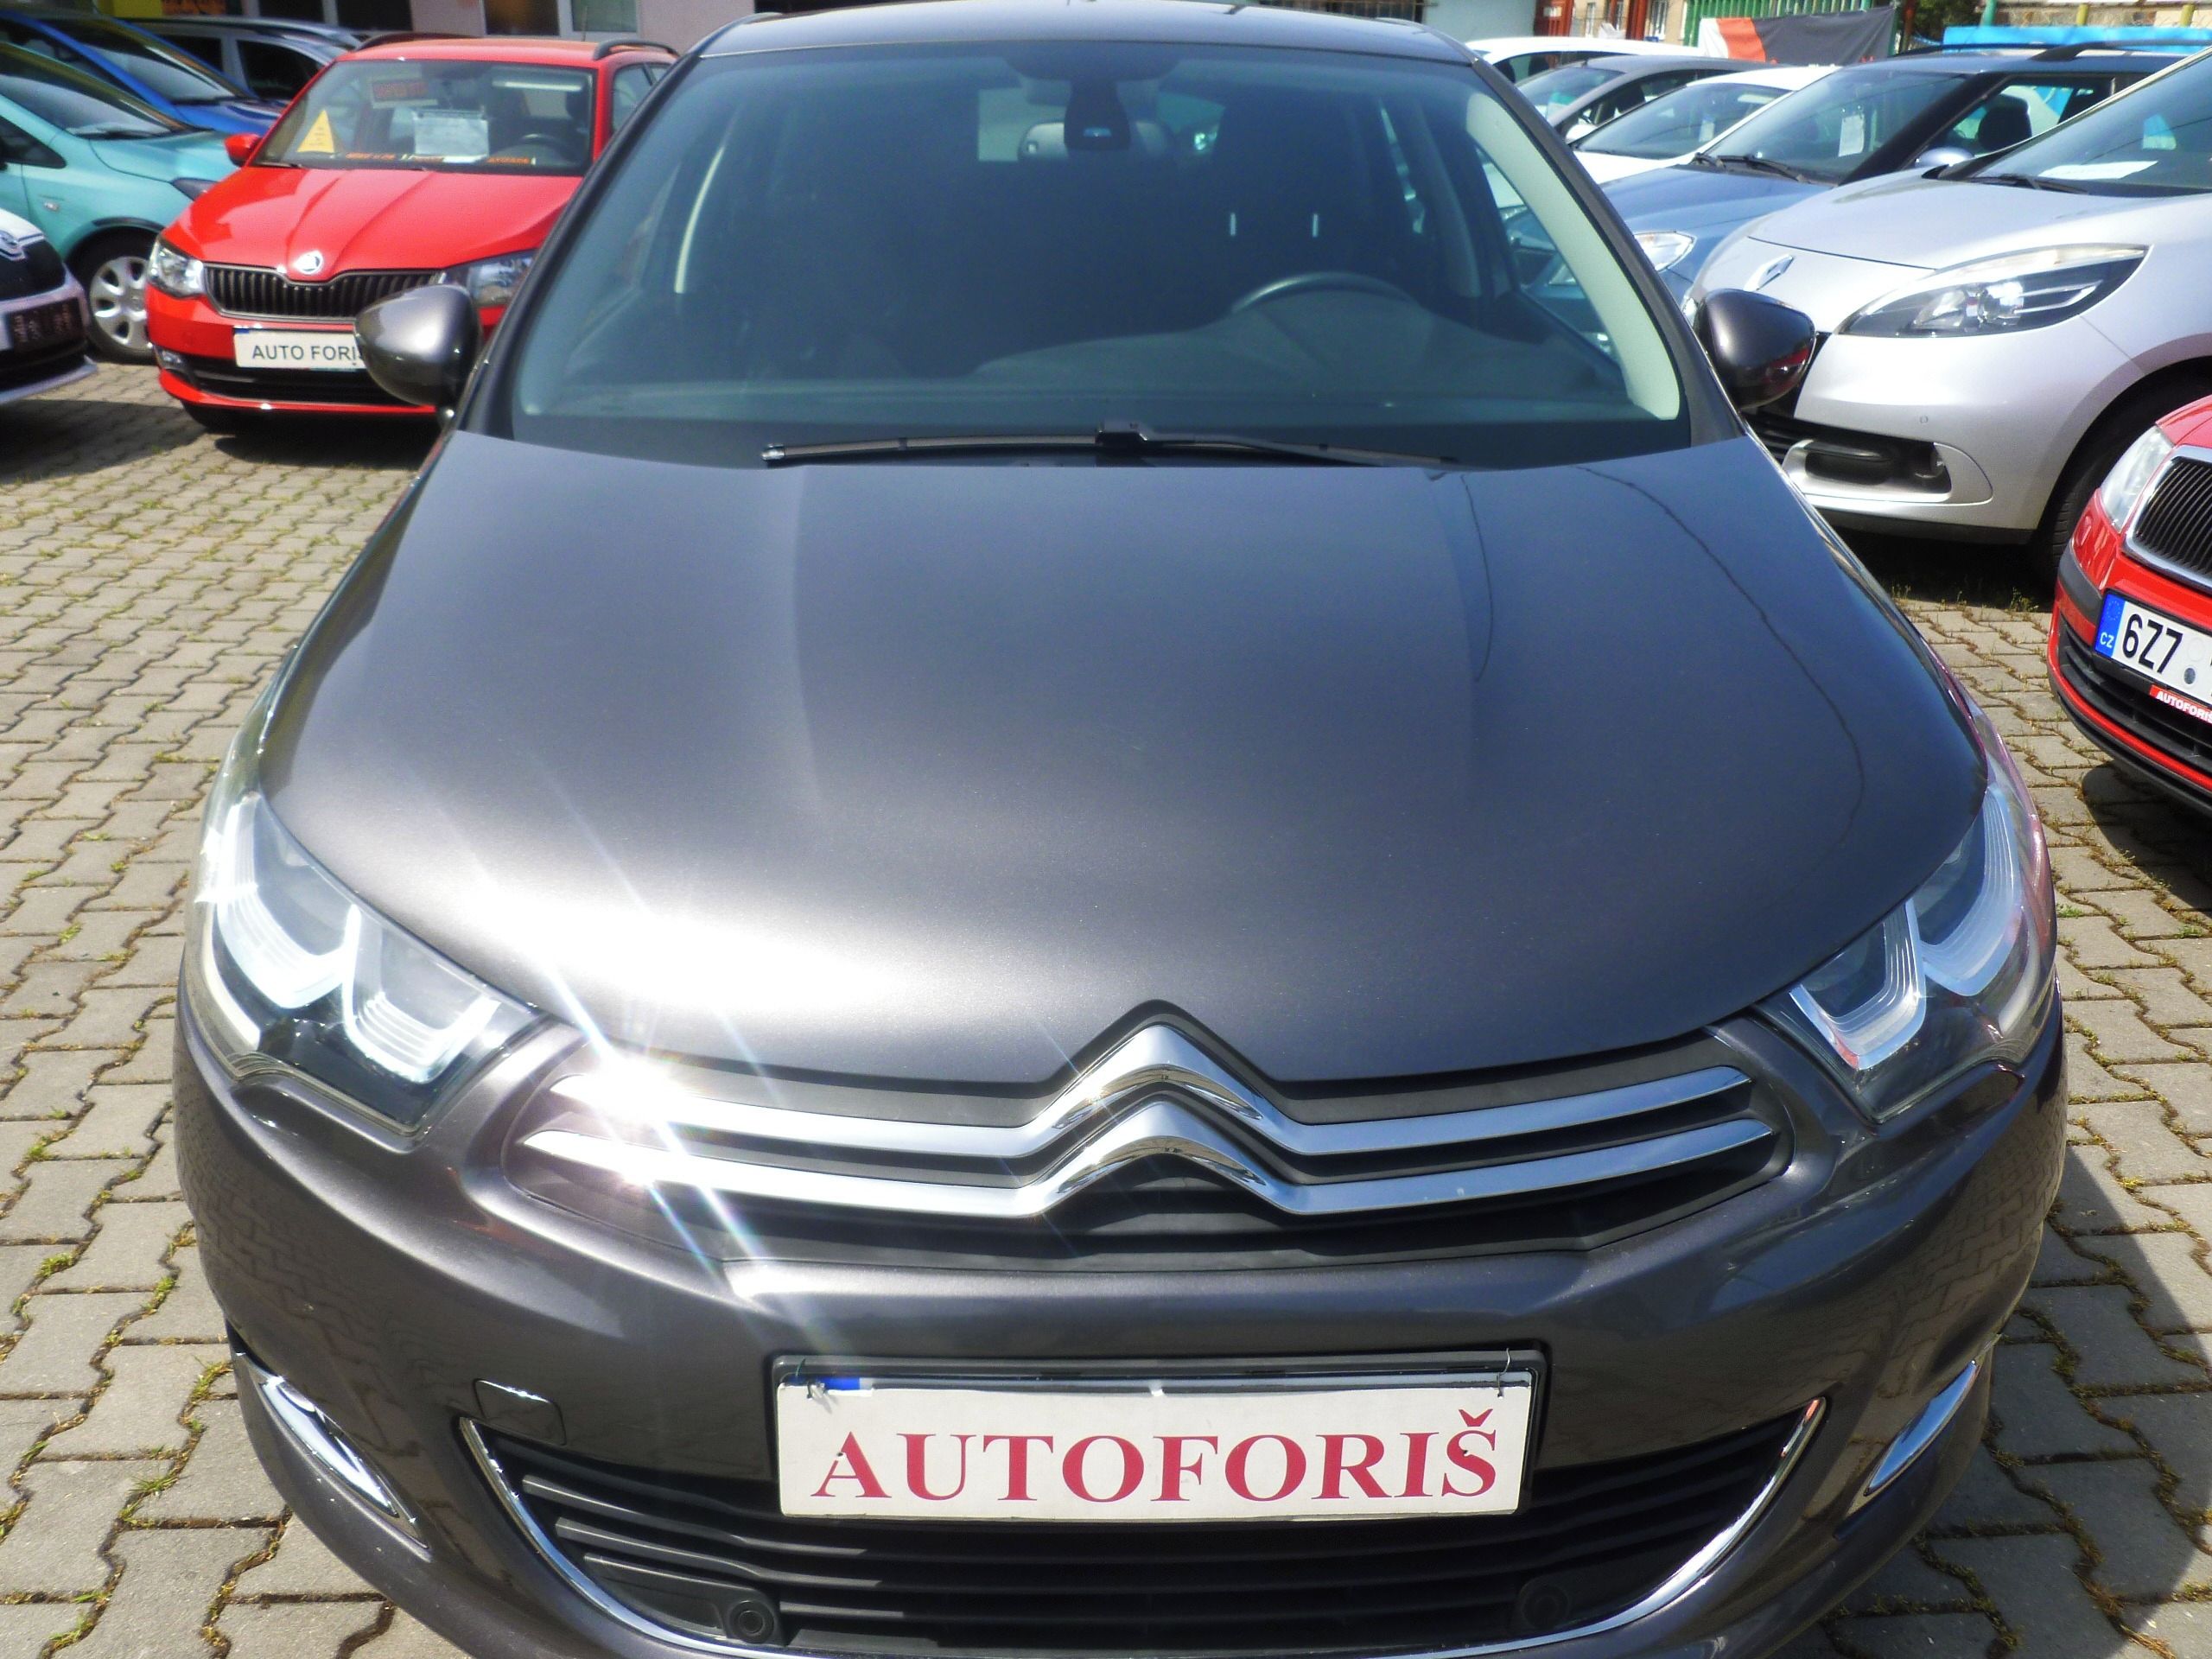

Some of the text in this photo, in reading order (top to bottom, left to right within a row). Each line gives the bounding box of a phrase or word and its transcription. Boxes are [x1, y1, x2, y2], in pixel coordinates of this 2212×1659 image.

[252, 345, 362, 360] AUTO FORI
[2100, 632, 2114, 648] CZ
[2122, 613, 2183, 674] 6Z7
[810, 1408, 1497, 1503] AUTOFORIŠ
